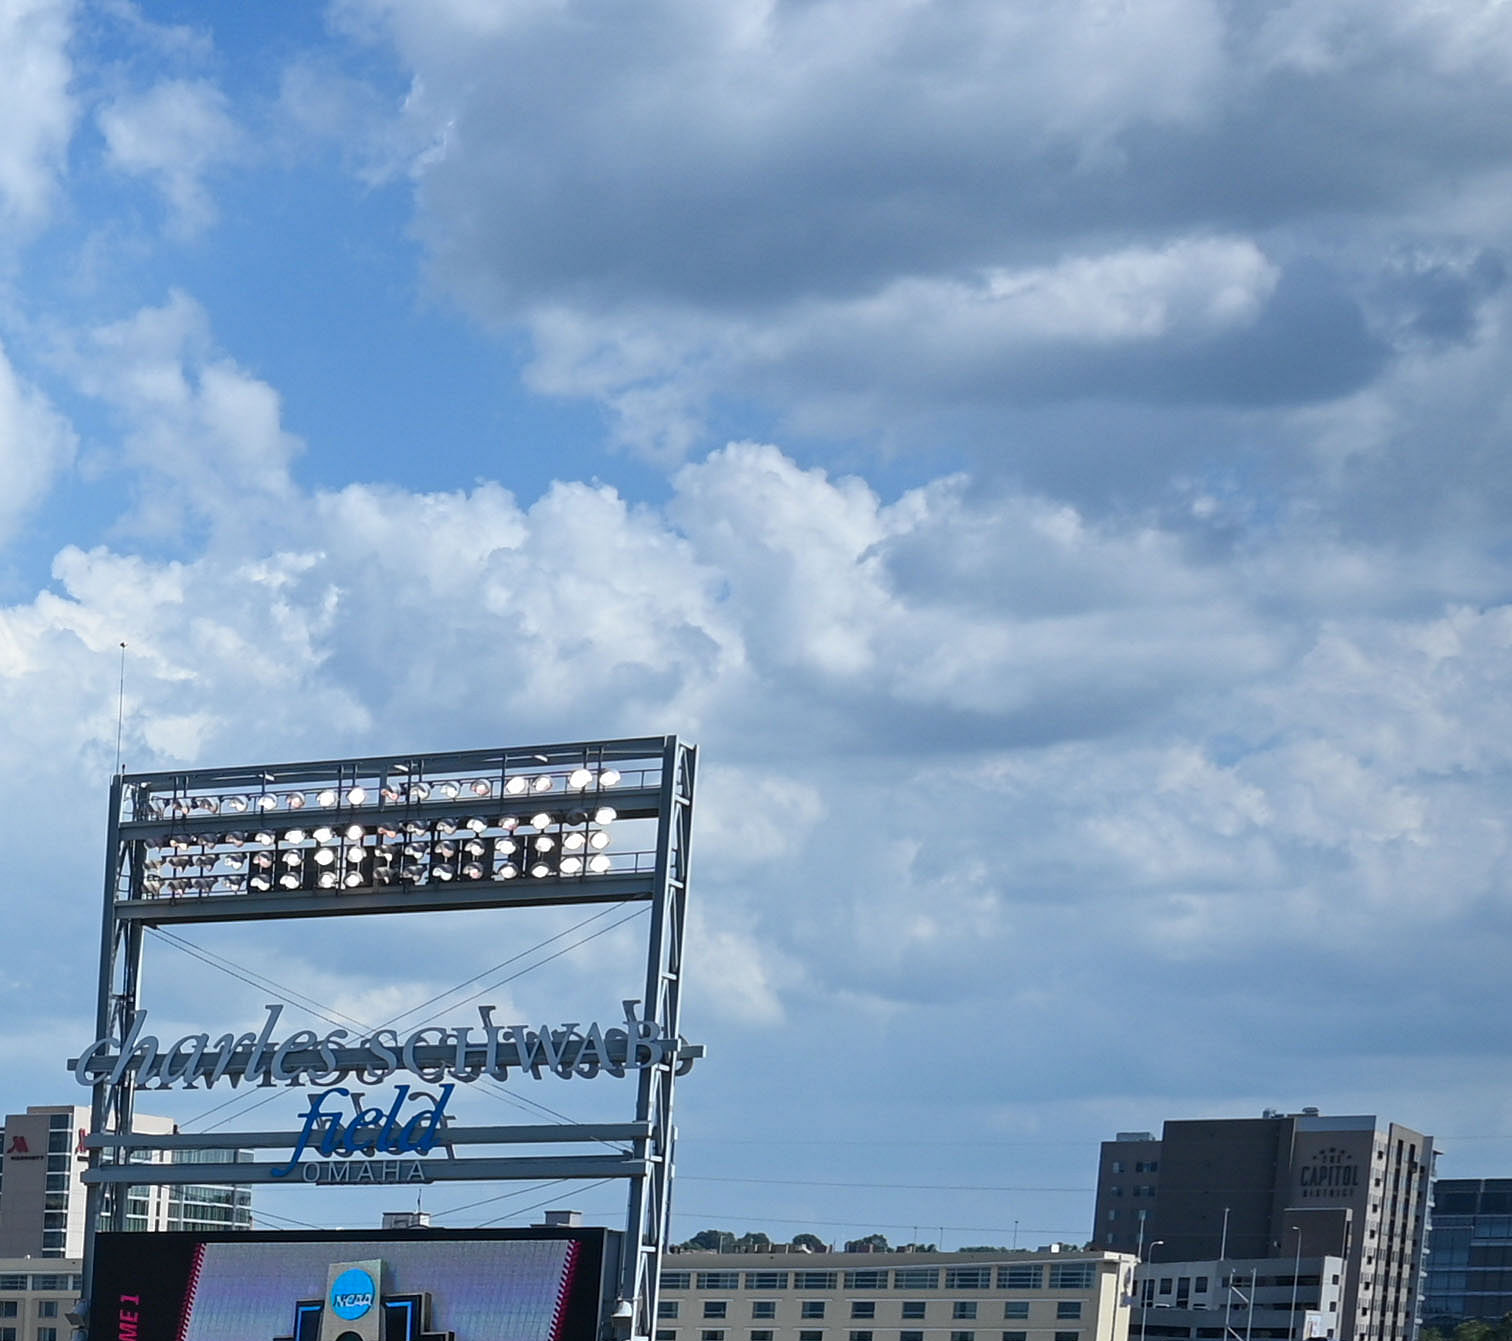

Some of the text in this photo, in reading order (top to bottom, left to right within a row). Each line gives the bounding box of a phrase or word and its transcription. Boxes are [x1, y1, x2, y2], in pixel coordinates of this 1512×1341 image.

[75, 1004, 343, 1088] charles
[271, 1083, 455, 1178] field
[302, 1161, 426, 1182] OMAHA
[1300, 1165, 1359, 1186] CAPITOL
[120, 1294, 140, 1305] 1
[333, 1293, 372, 1308] NCAA
